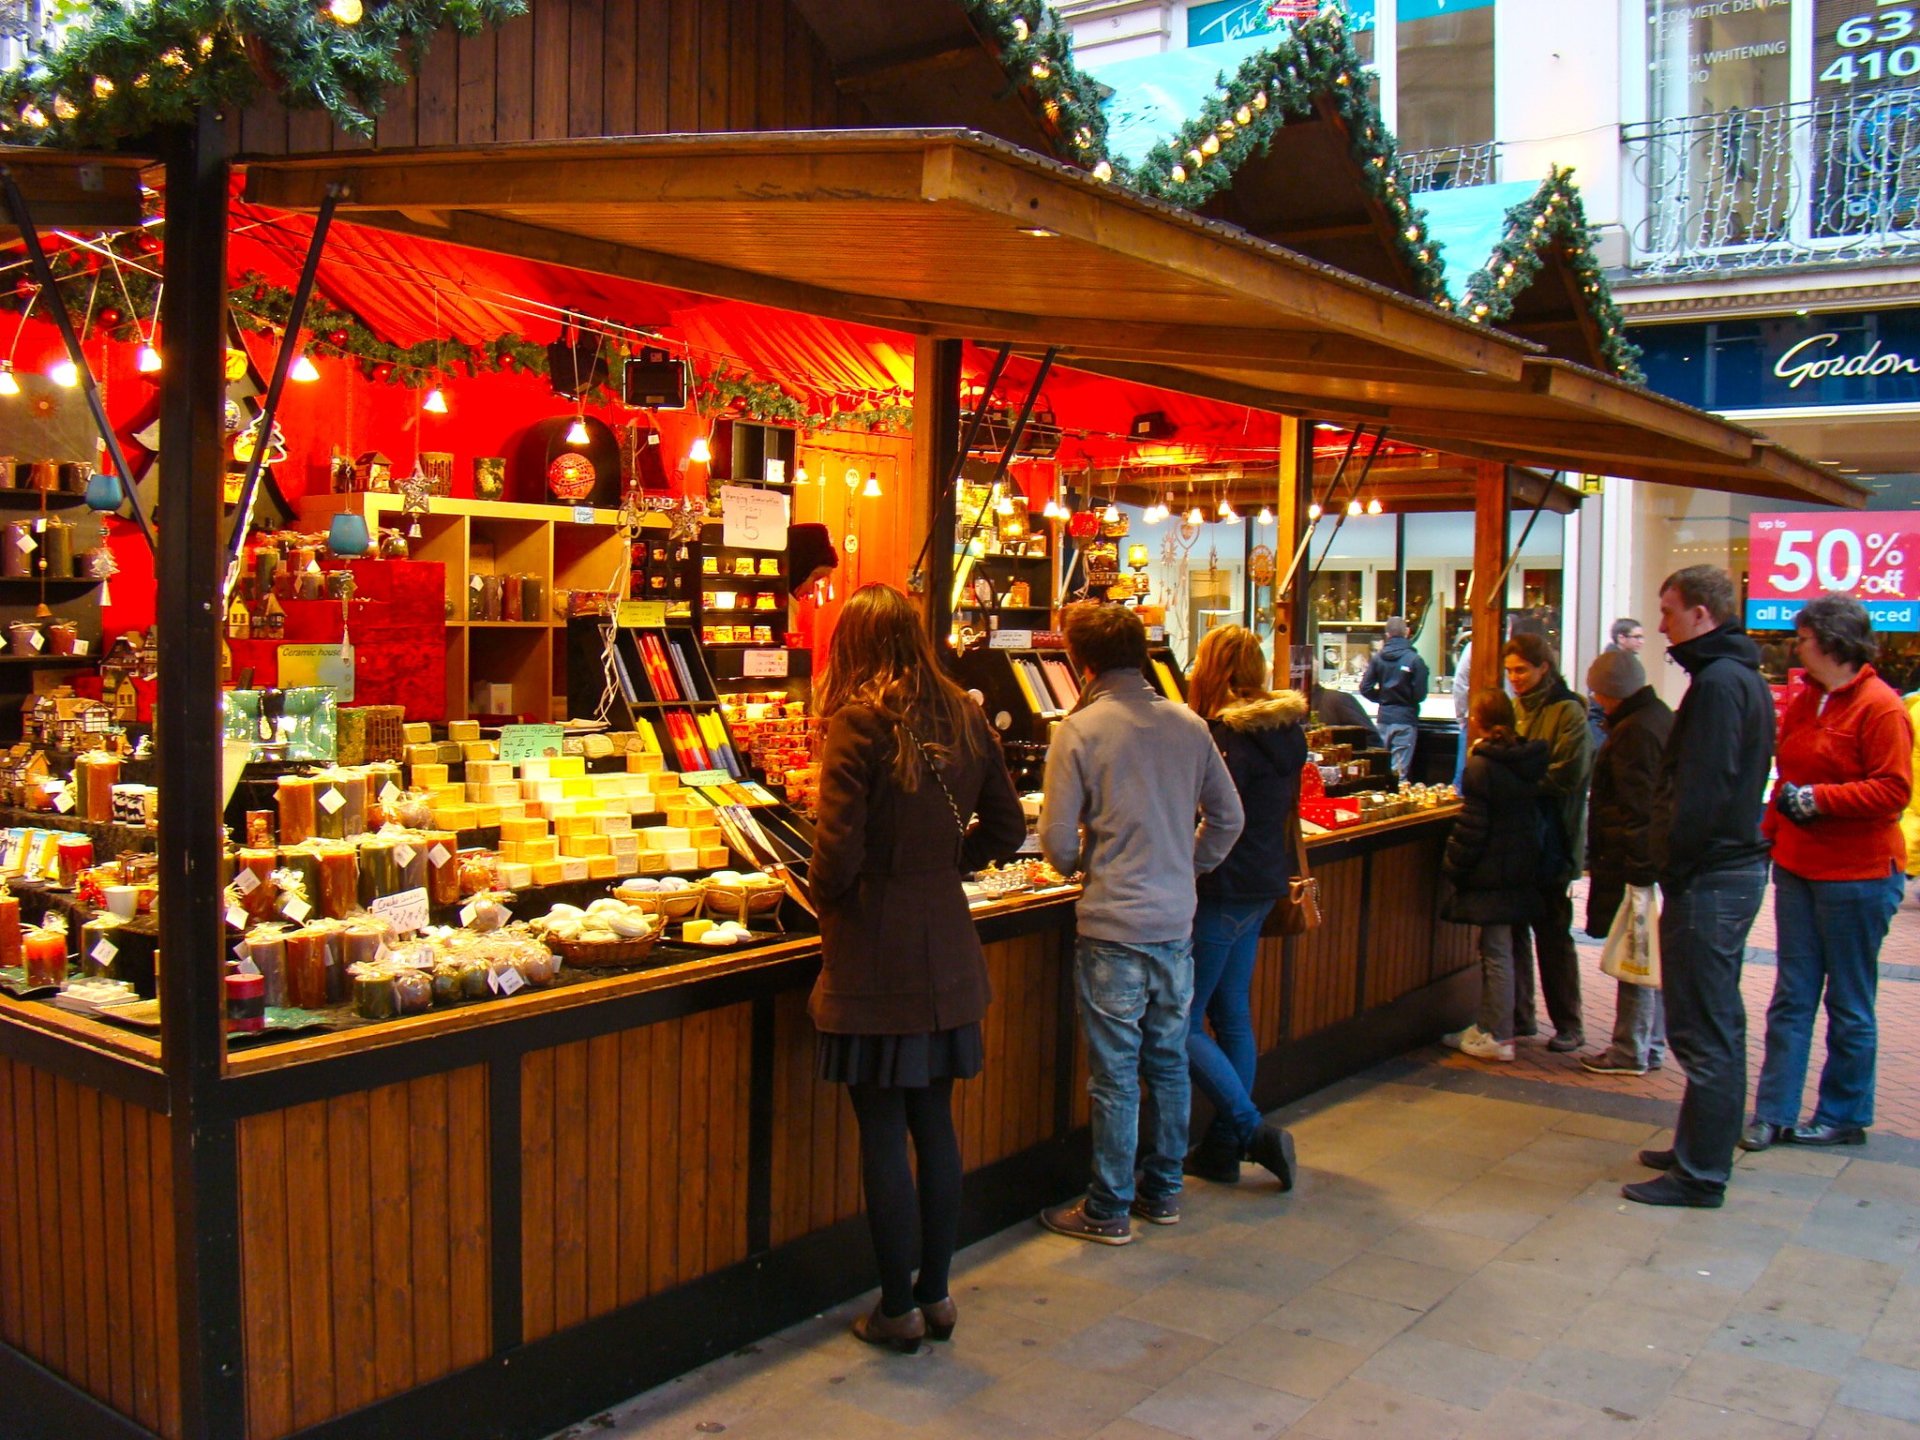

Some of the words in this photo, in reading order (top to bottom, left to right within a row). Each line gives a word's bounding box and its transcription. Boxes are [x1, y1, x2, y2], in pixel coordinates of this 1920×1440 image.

[1660, 1, 1730, 25] COSMETIC
[1660, 24, 1695, 41] CAE
[1836, 10, 1920, 48] 63
[1659, 53, 1700, 72] TEH
[1703, 41, 1787, 65] WHITENING
[1658, 69, 1710, 89] STDIO
[1774, 333, 1920, 388] Gordon
[1758, 520, 1774, 530] up
[1775, 519, 1787, 529] to
[1864, 569, 1904, 594] off
[1756, 606, 1777, 621] all
[282, 648, 317, 657] Ceramic
